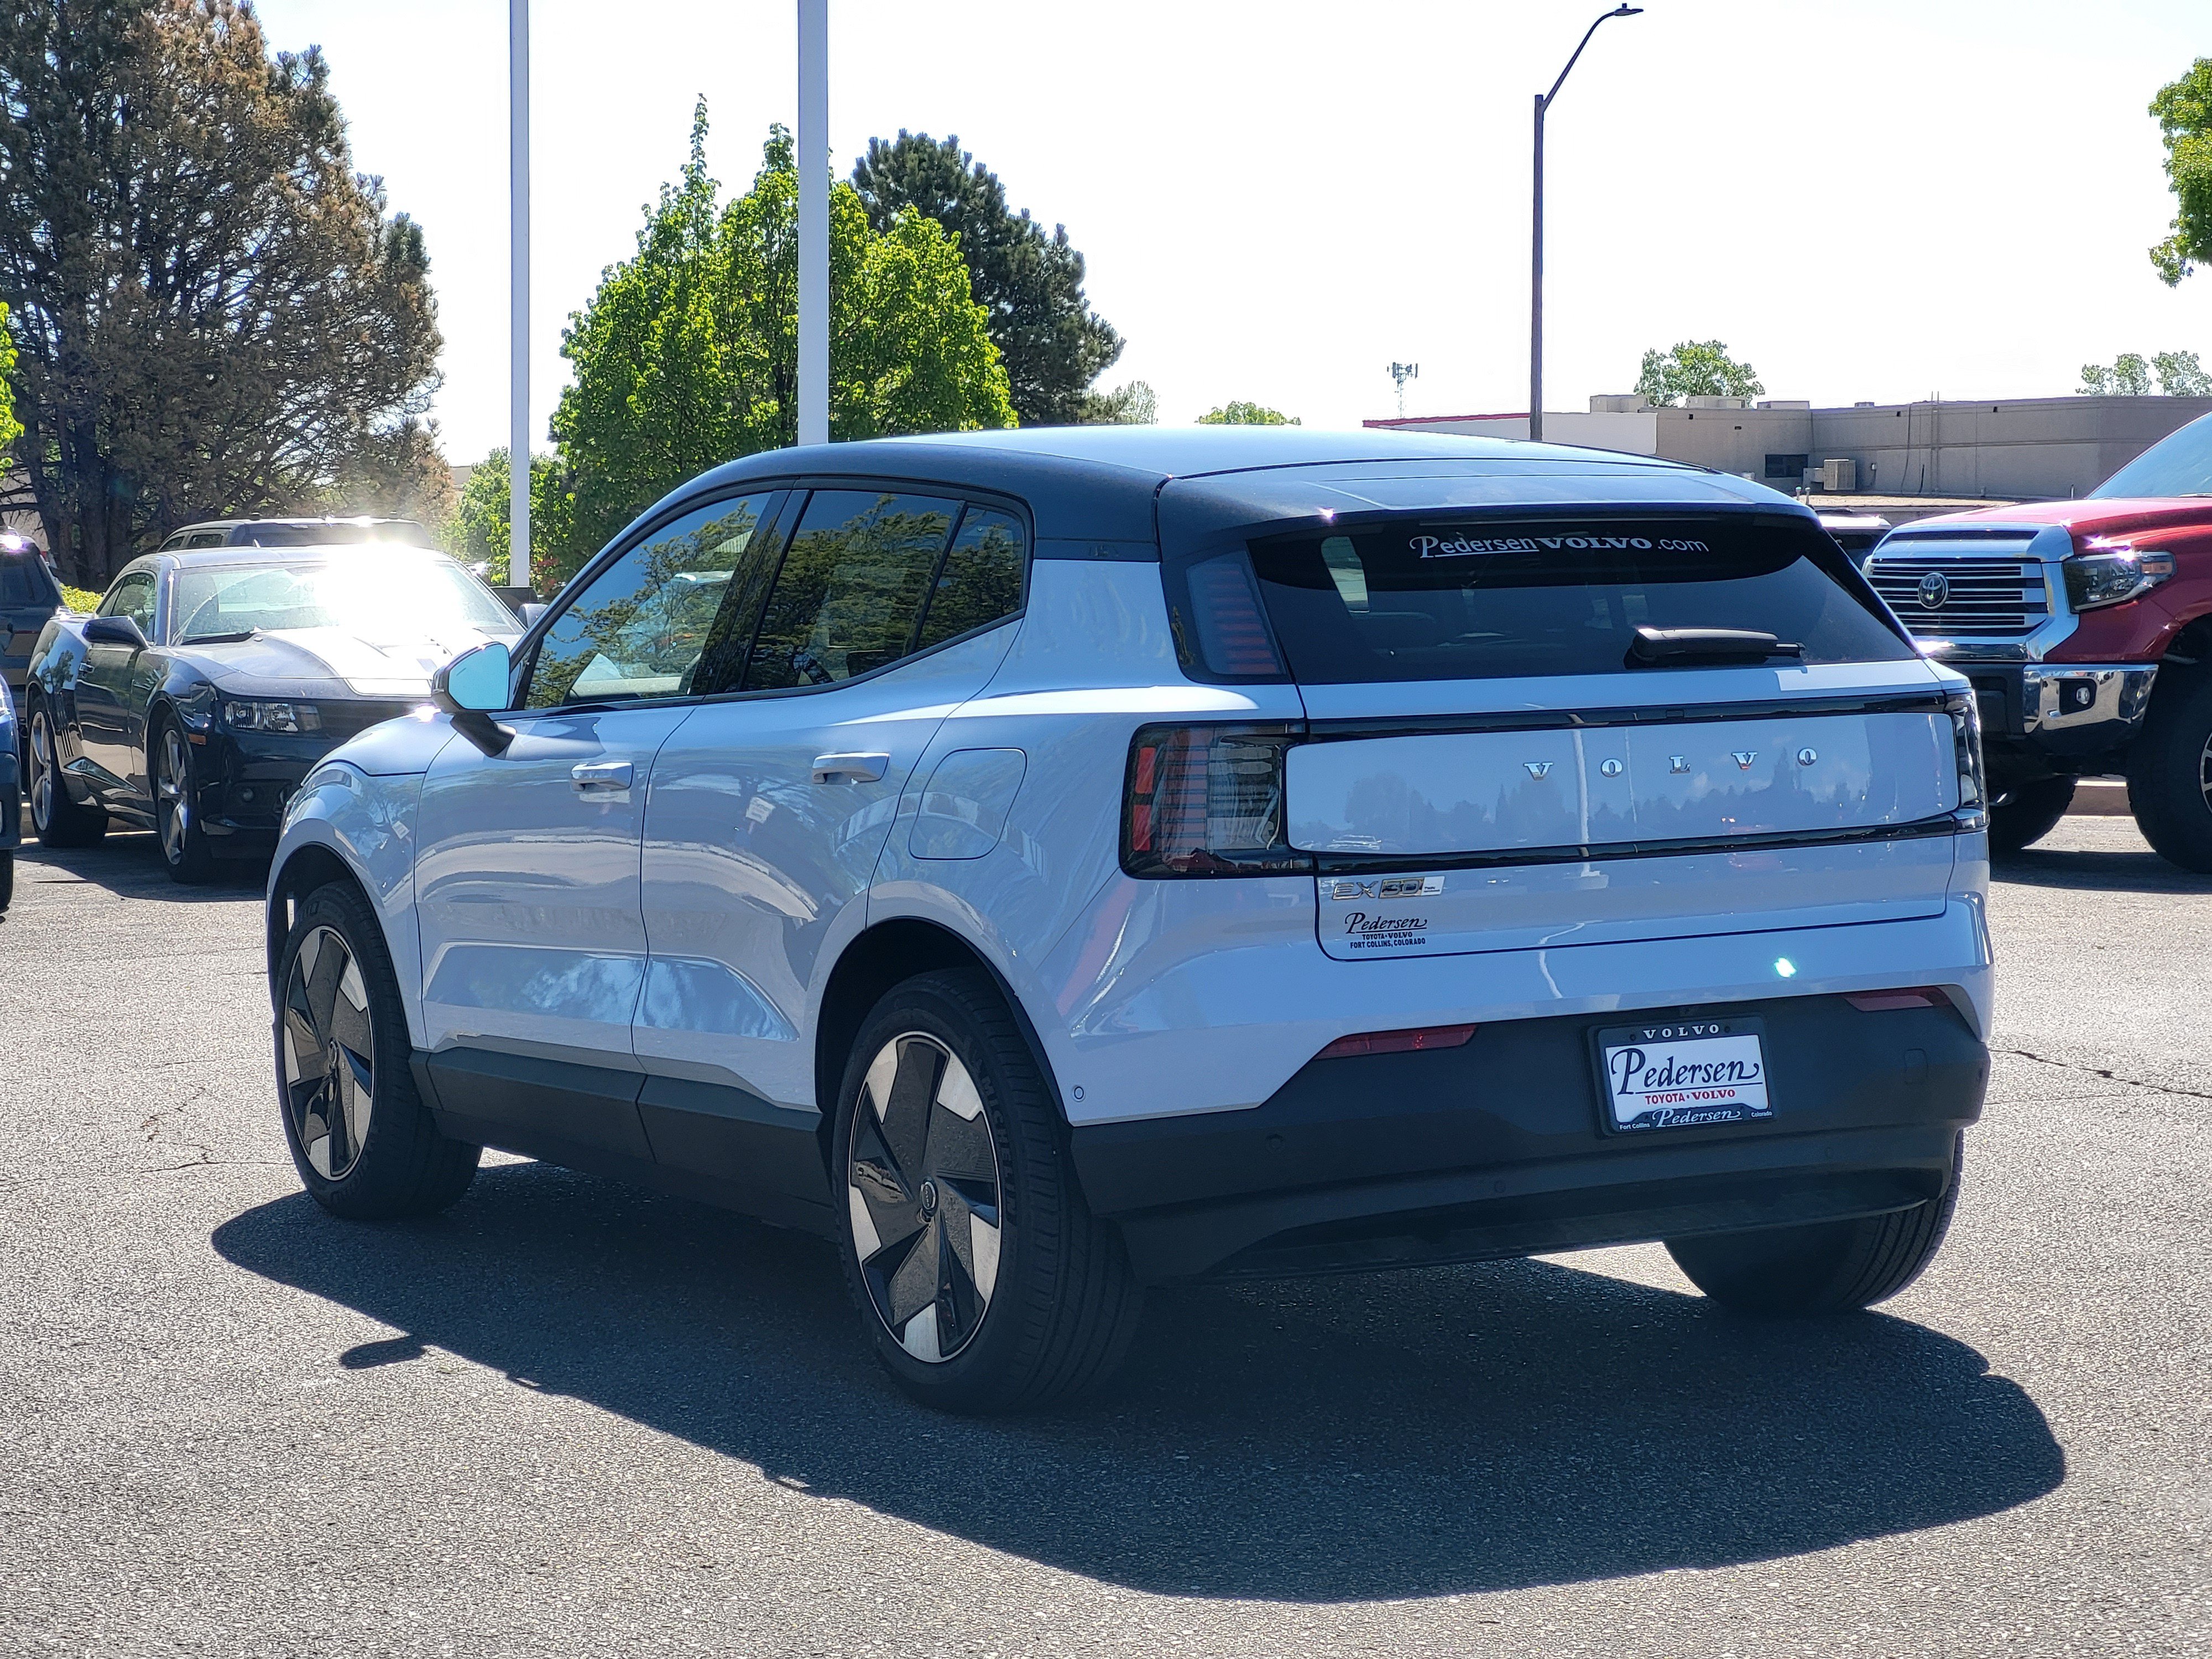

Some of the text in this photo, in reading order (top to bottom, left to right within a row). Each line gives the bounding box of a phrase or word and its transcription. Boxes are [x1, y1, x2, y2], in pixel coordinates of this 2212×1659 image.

[1524, 747, 1817, 781] VOLVO
[1344, 912, 1427, 934] Pedersen
[1367, 940, 1393, 948] COLLINS,
[1394, 937, 1426, 947] COLORADO
[1643, 1024, 1719, 1039] VOLVO
[1610, 1048, 1762, 1095] Pedersen
[1652, 1108, 1742, 1128] Pedersen
